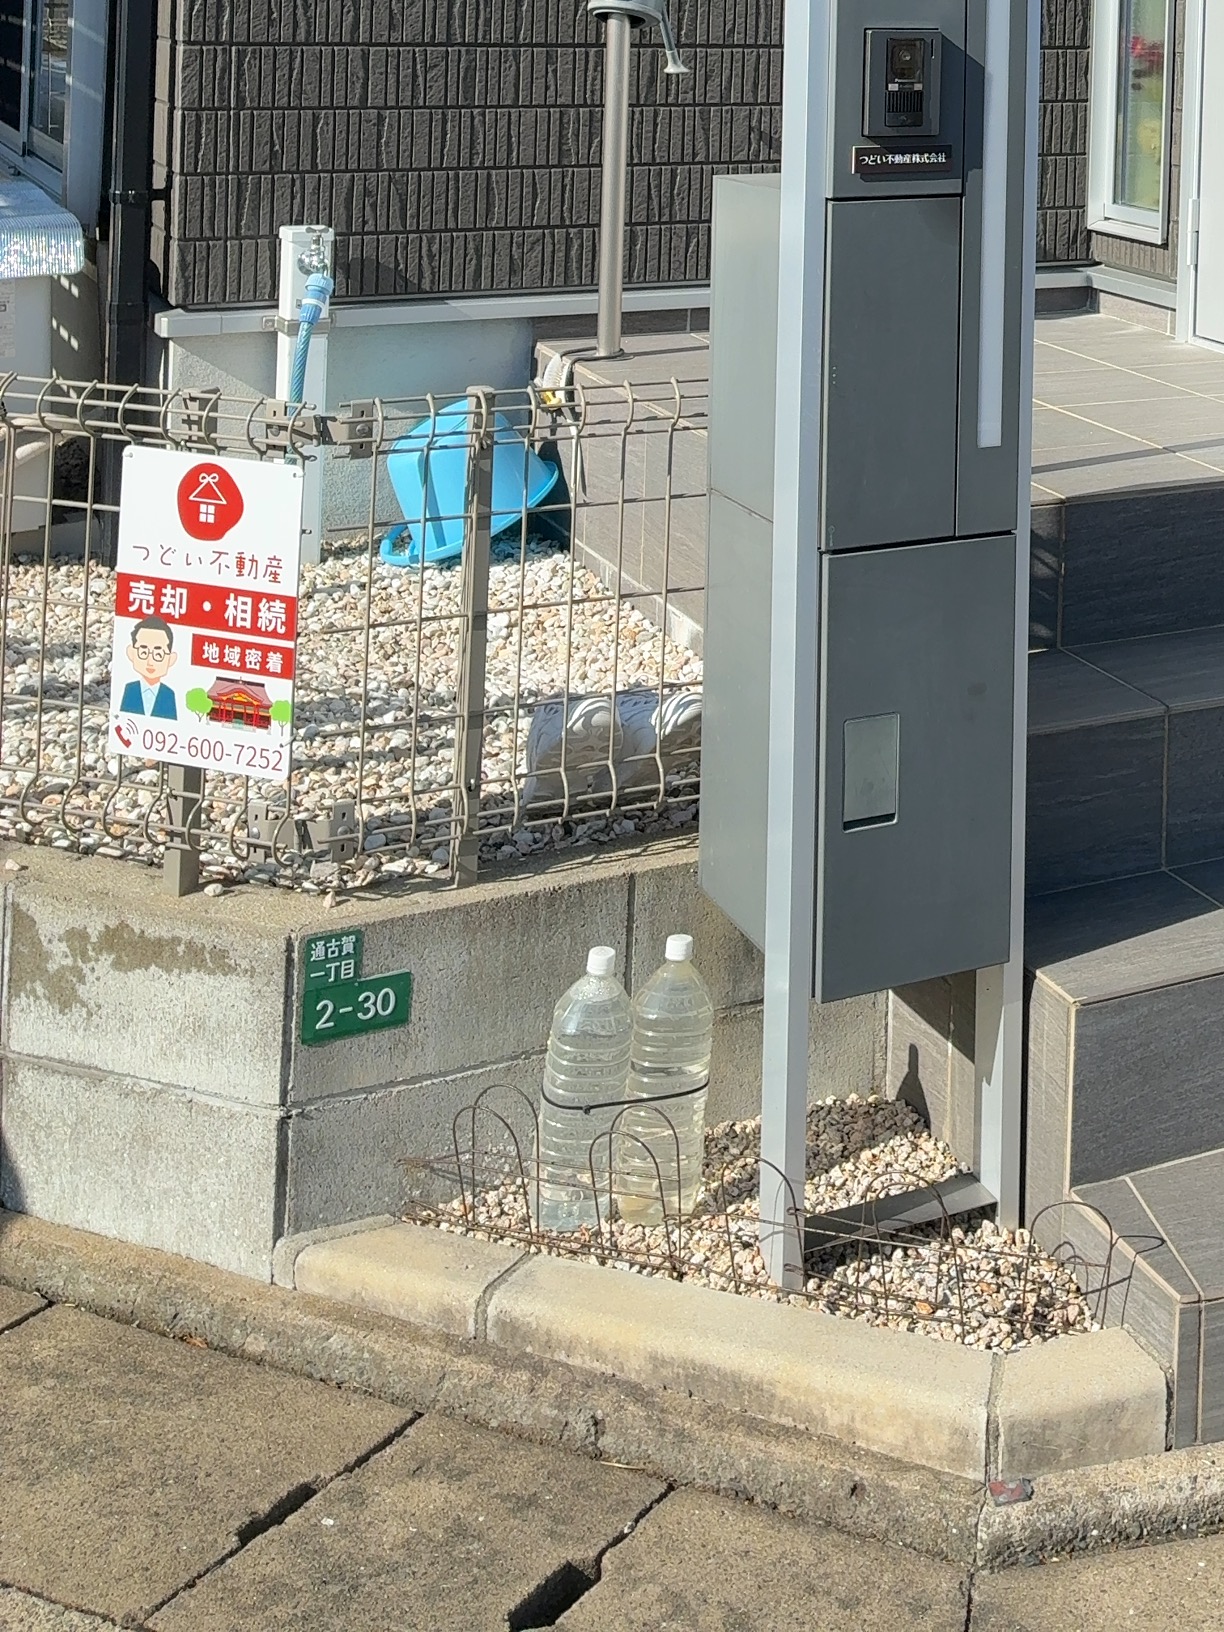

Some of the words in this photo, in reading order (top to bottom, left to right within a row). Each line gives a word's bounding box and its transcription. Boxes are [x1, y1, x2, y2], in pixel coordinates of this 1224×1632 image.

[859, 152, 947, 165] つどい不動産株式会社
[132, 544, 284, 584] つどい不動産
[128, 580, 287, 635] 売却・相続
[202, 642, 284, 674] 地域密着
[142, 729, 284, 772] 092-600-7252
[310, 935, 356, 962] 通古賀
[310, 959, 355, 982] 一丁目
[315, 987, 396, 1030] 2-30
